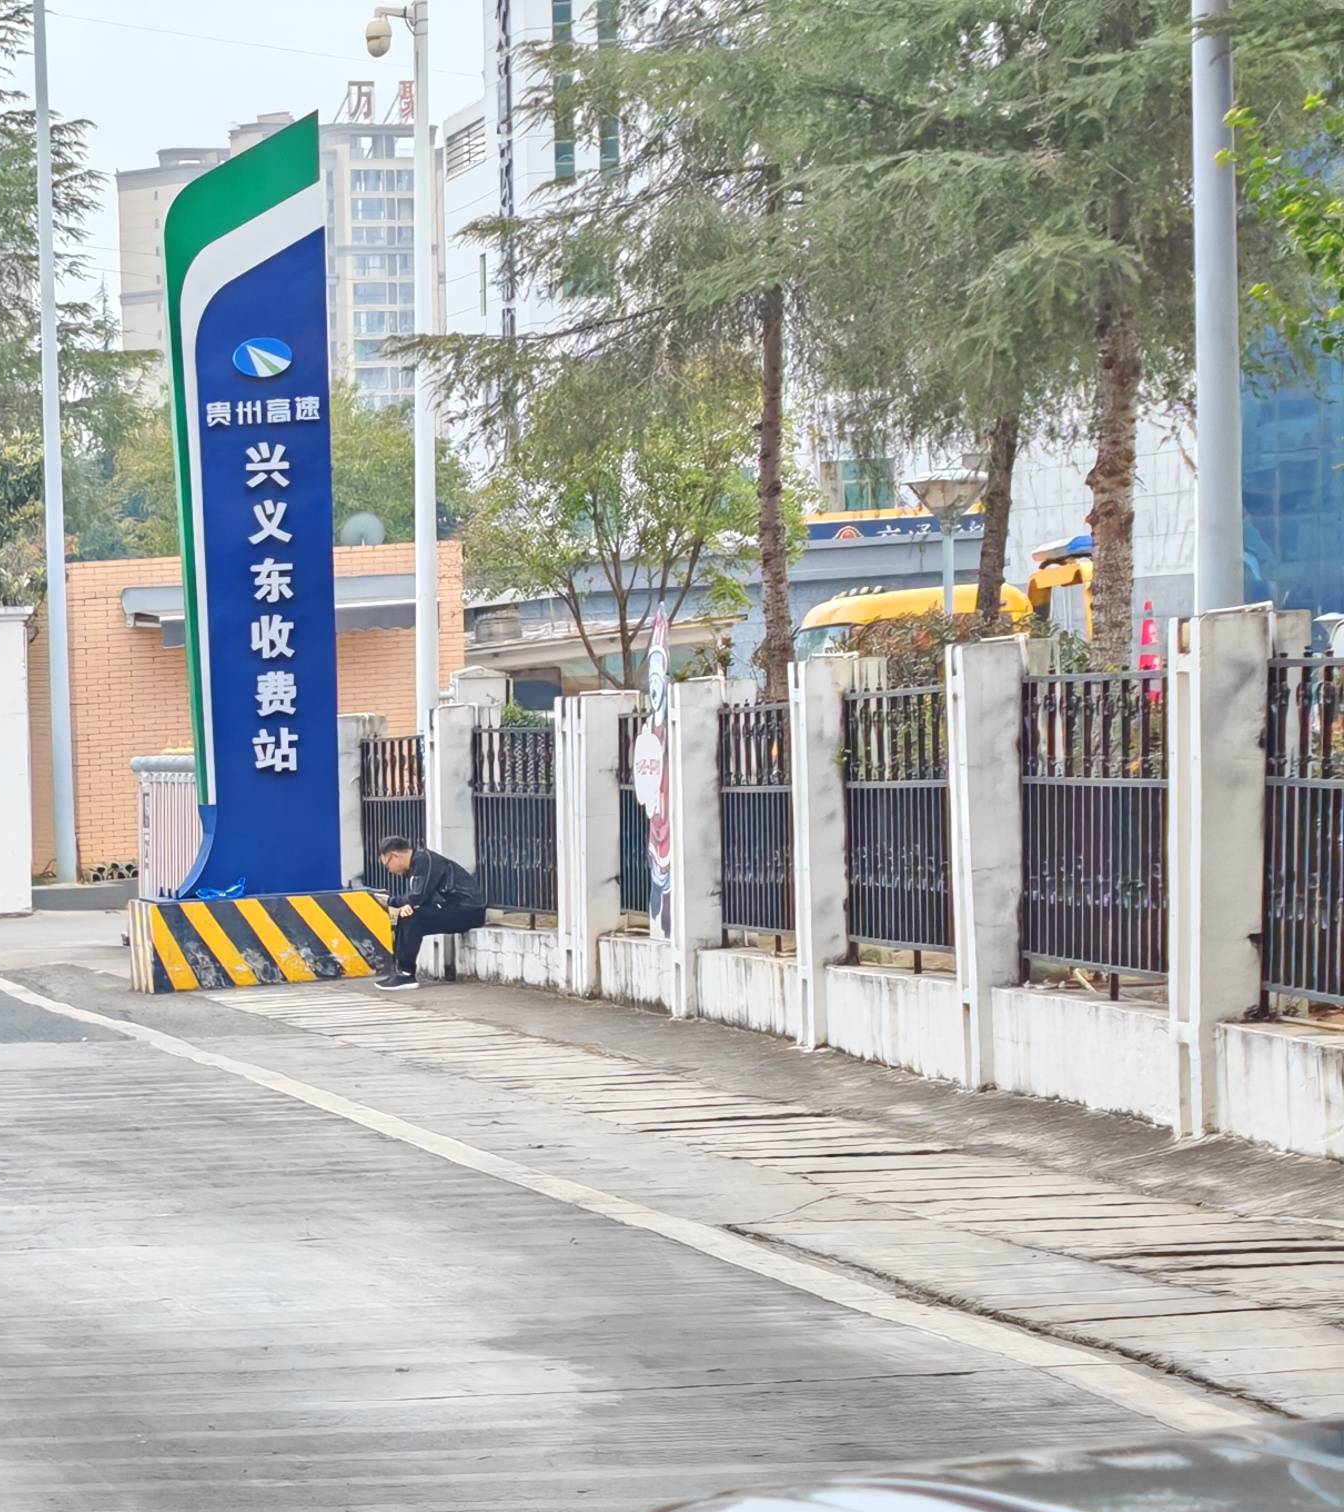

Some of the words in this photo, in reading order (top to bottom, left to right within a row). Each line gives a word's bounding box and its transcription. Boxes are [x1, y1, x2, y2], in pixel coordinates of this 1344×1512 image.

[206, 396, 320, 427] 贵州高速
[245, 442, 298, 772] 兴义东收费站
